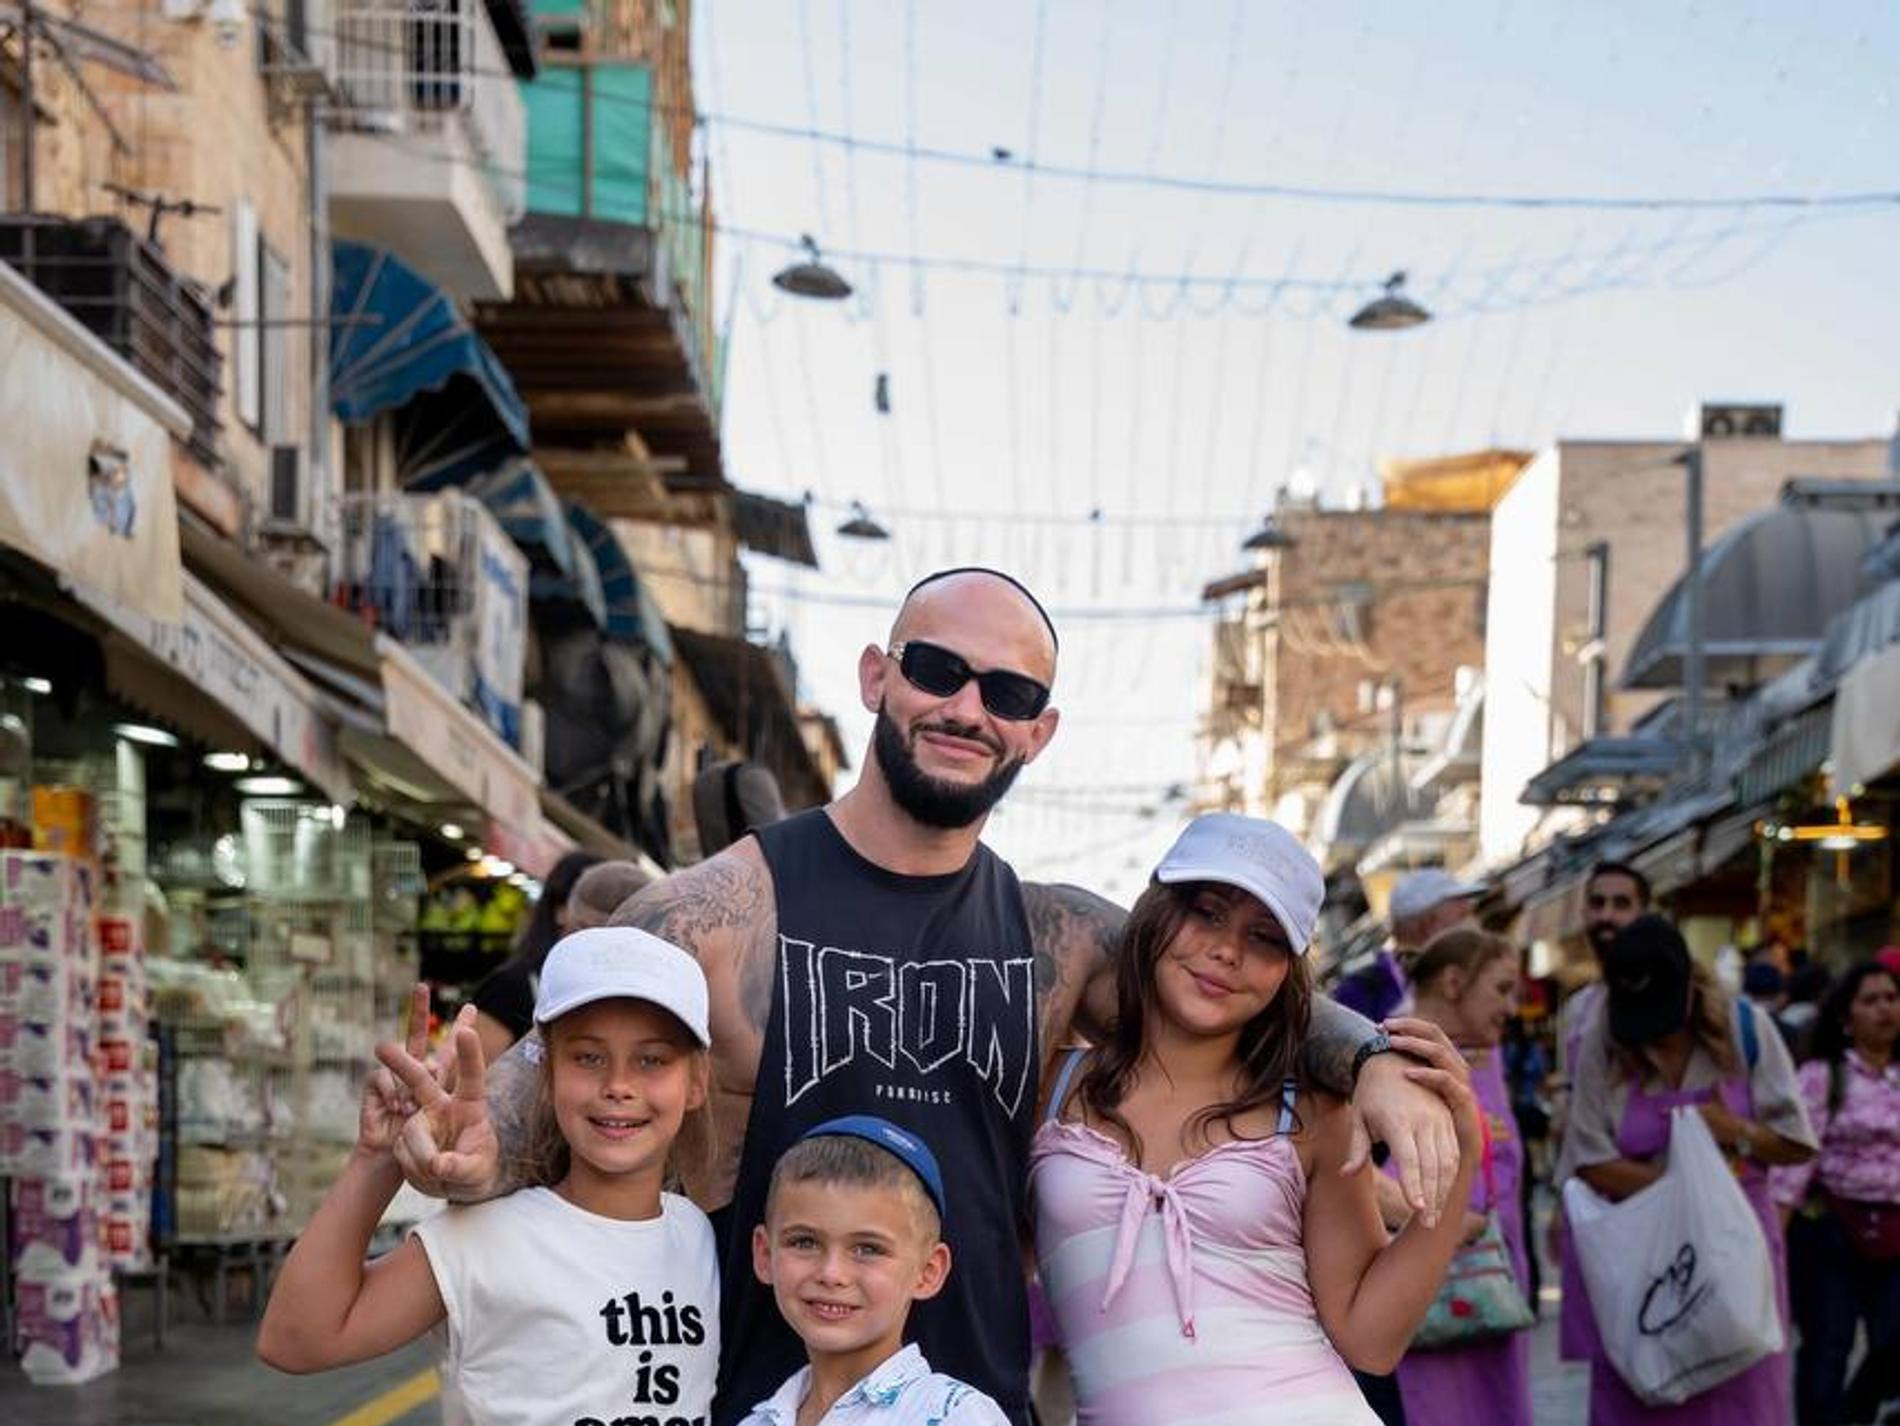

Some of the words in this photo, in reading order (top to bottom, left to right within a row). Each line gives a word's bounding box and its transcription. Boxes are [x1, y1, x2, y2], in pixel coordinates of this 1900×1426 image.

[778, 932, 1035, 1120] IRON
[599, 1290, 705, 1346] this
[633, 1350, 680, 1405] is
